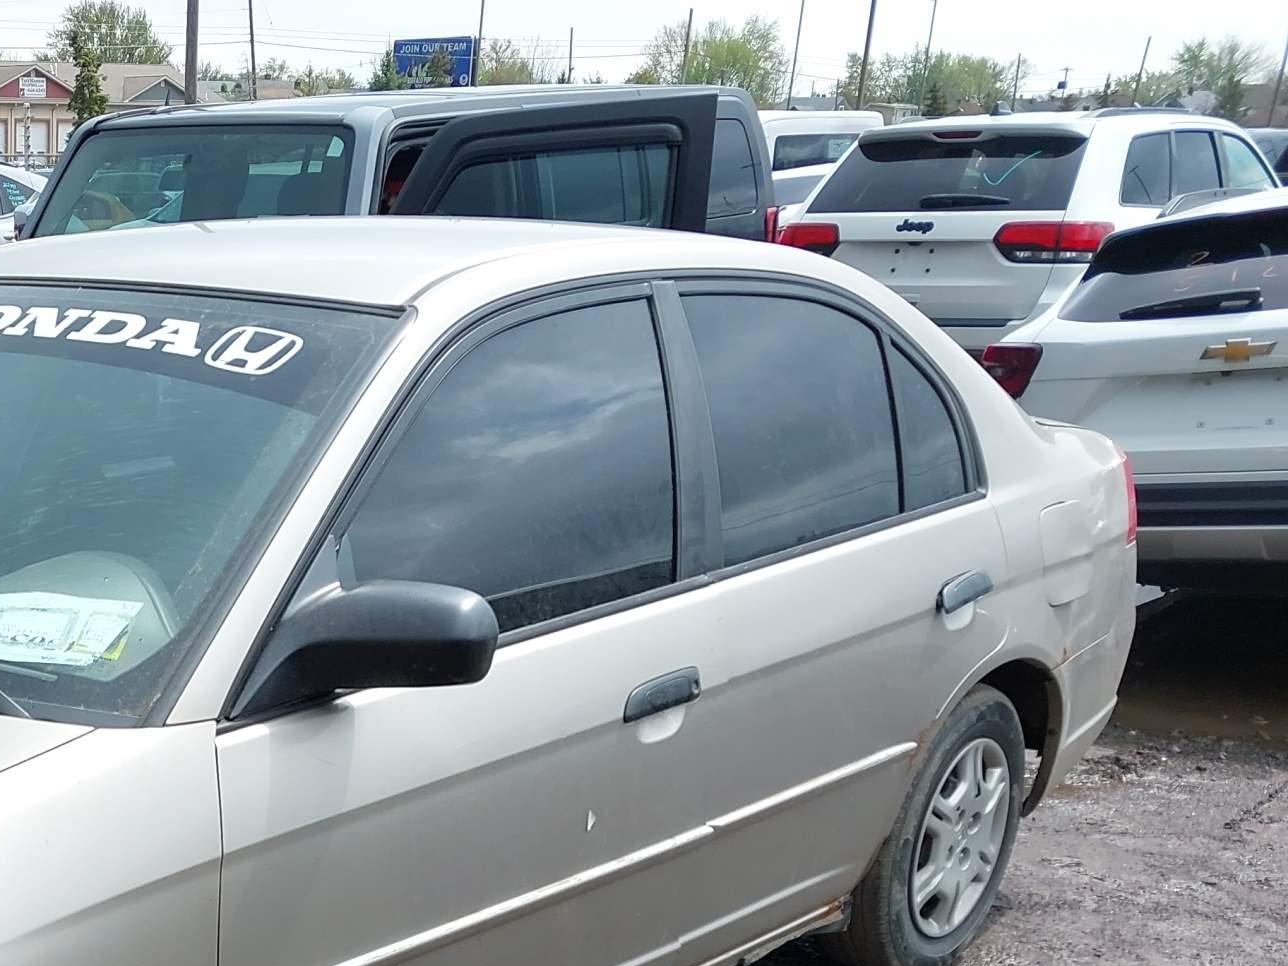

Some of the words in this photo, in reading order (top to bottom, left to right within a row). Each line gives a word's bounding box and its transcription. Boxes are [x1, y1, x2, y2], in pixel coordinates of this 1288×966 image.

[400, 44, 420, 54] JOIN
[422, 43, 440, 52] OUR
[443, 42, 467, 51] TEAM
[896, 219, 934, 235] Jeep
